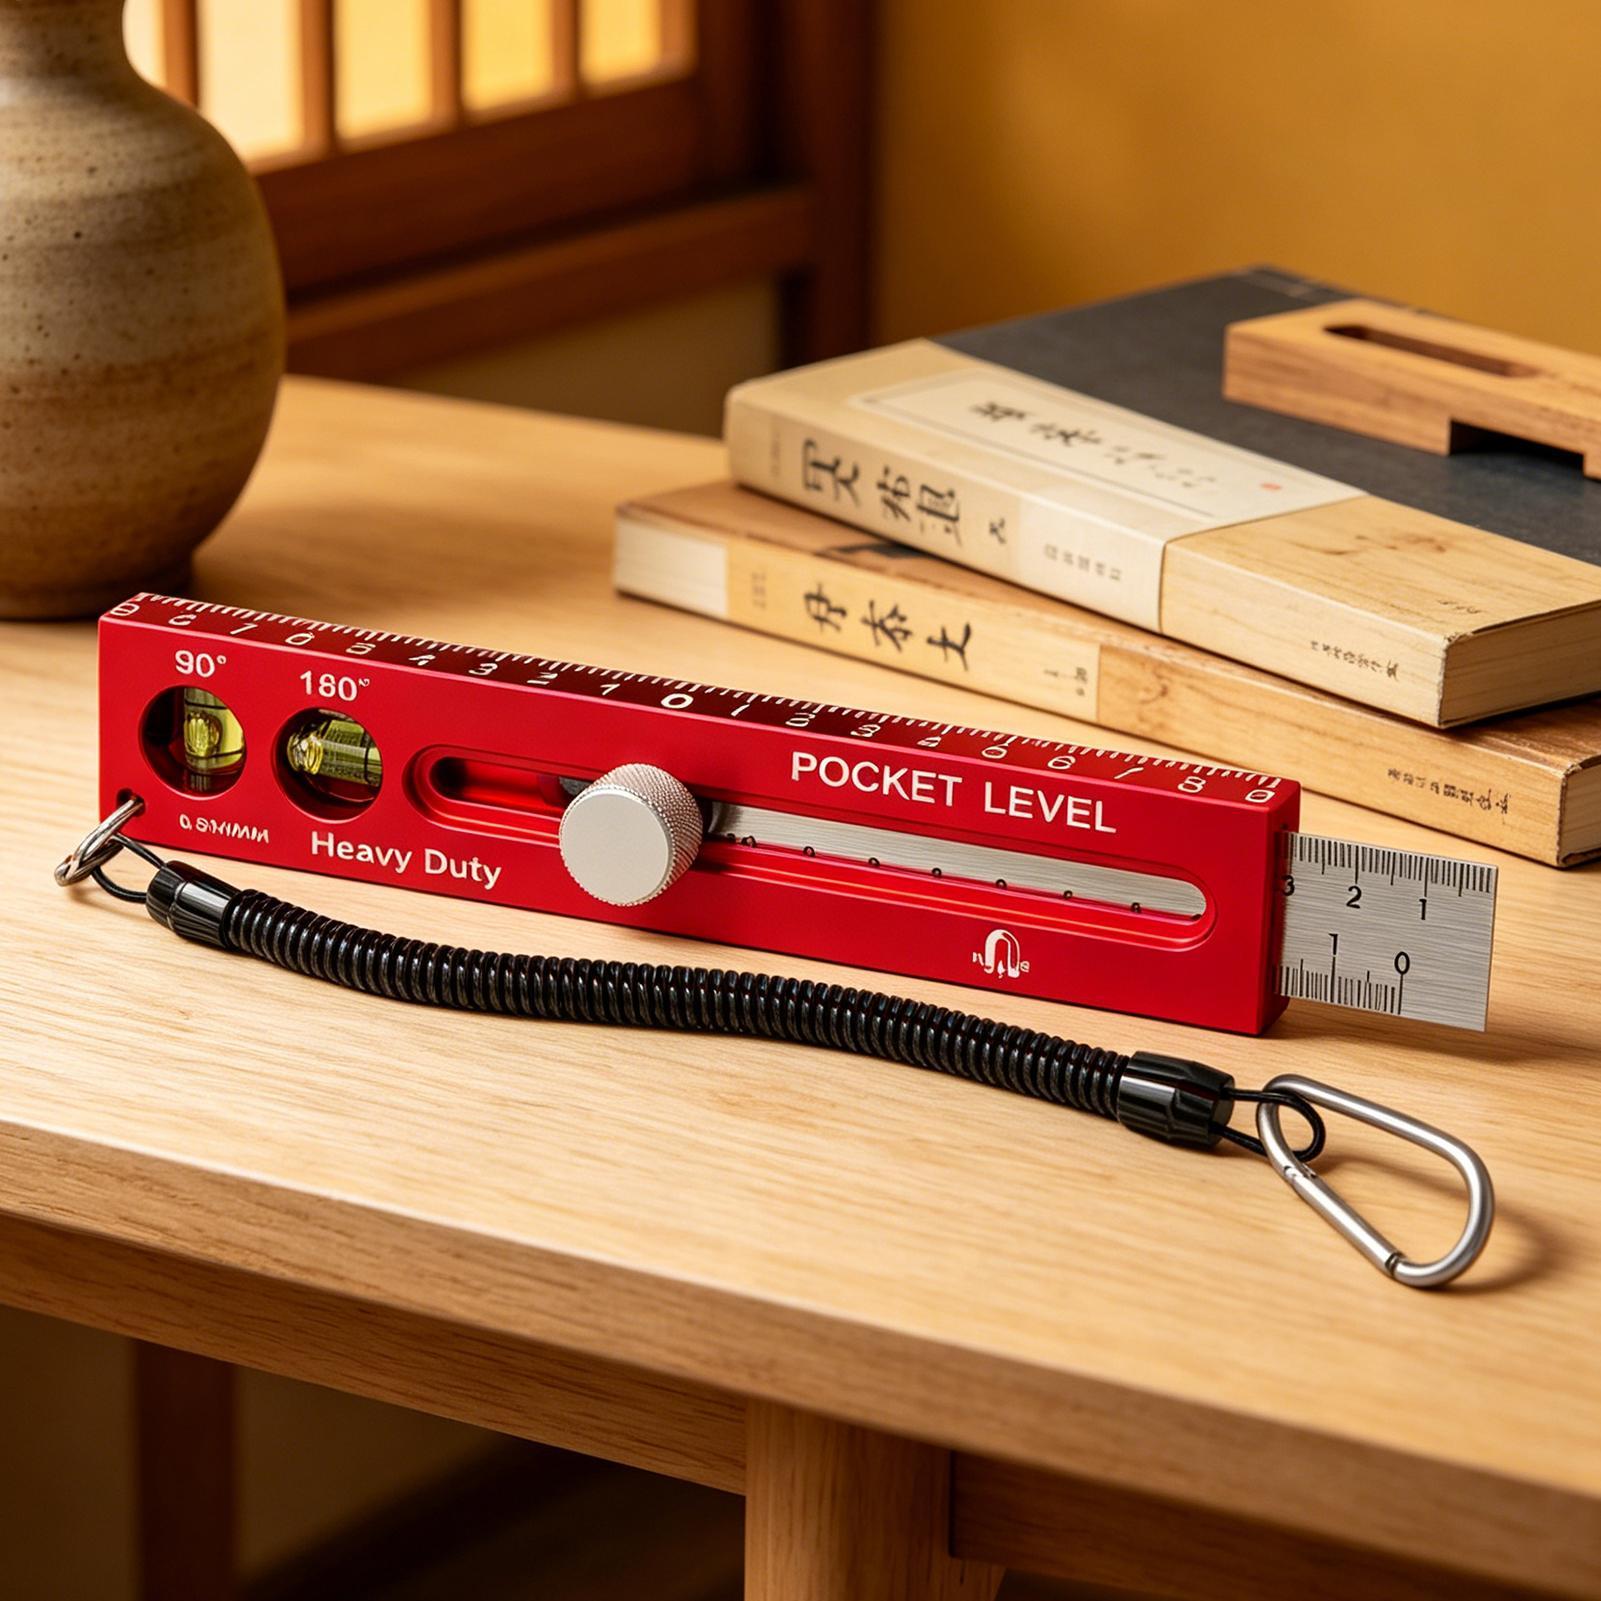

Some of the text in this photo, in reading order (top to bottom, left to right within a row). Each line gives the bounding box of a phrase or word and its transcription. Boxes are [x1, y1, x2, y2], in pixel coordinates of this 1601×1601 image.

[660, 693, 694, 709] 0
[1177, 776, 1206, 793] 8
[792, 751, 1117, 833] POCKET LEVEL
[311, 831, 502, 890] Heavy Duty
[1346, 885, 1362, 909] 2
[1419, 898, 1428, 921] 1
[1328, 933, 1411, 975] 1 0
